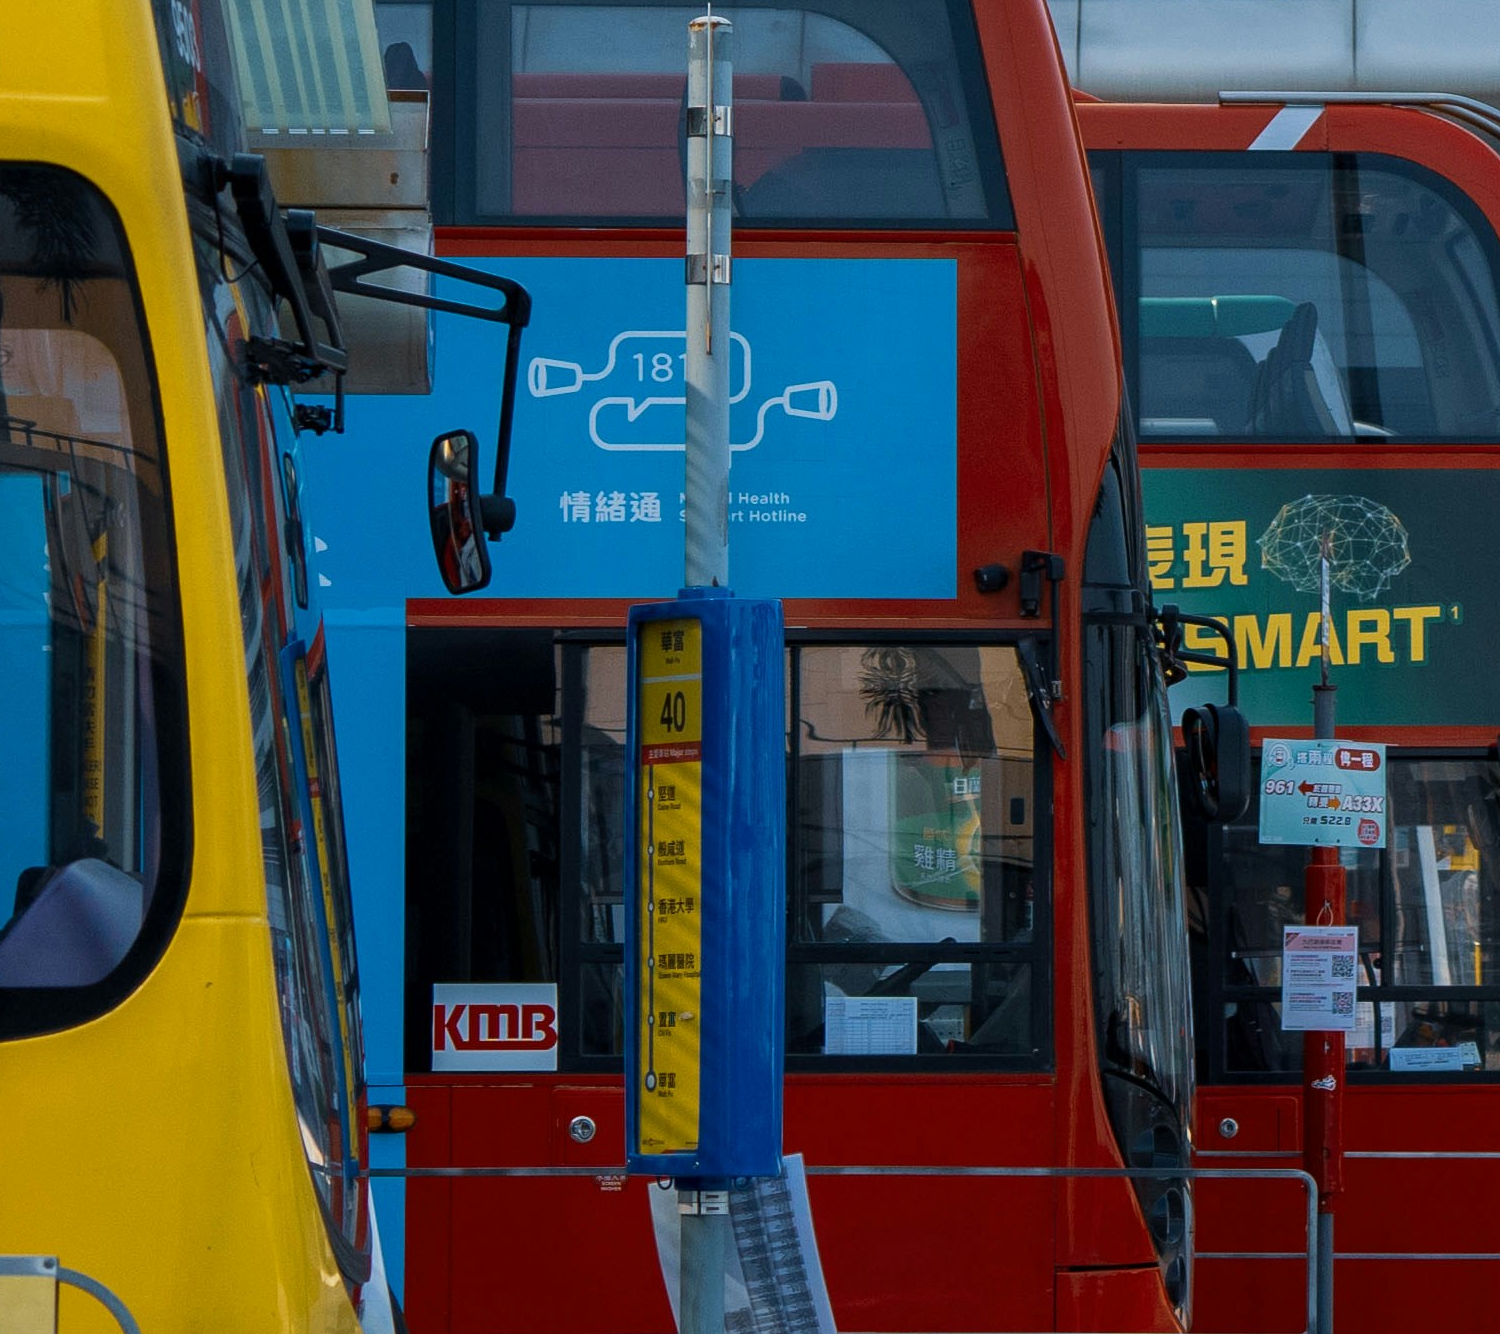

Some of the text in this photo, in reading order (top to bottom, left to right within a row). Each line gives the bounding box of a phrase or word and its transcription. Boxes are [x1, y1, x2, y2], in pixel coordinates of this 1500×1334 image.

[559, 490, 662, 524] 情緒通
[739, 492, 790, 504] Health
[749, 510, 807, 523] Hotline
[660, 691, 686, 733] 40
[1264, 779, 1296, 795] 961
[1340, 794, 1384, 813] A33X
[914, 844, 957, 871] 雞精
[658, 898, 694, 914] 香港大學
[434, 1004, 557, 1051] KMB
